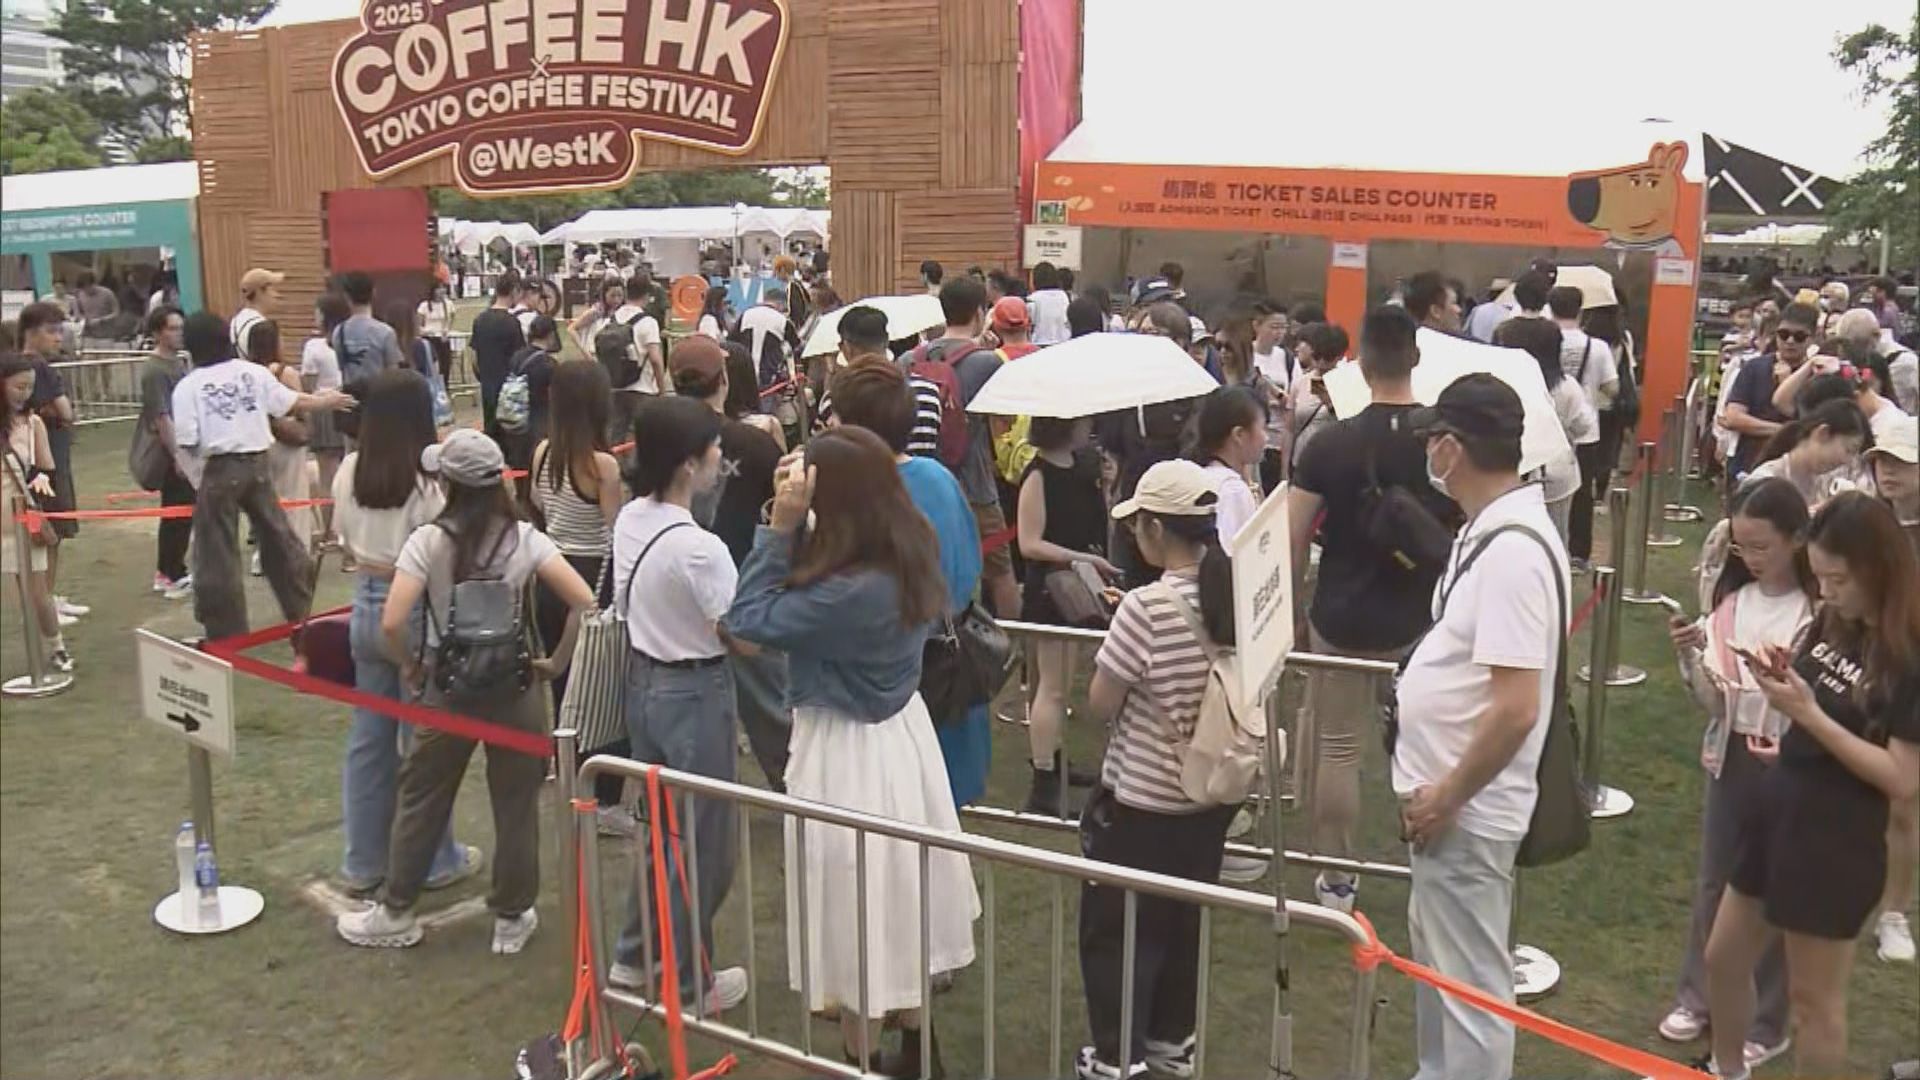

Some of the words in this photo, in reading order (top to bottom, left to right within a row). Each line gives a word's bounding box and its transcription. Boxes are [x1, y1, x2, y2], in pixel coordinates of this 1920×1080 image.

[374, 3, 424, 27] 2025
[342, 0, 625, 113] COFFEE
[643, 0, 773, 87] HK
[364, 96, 461, 155] TOKYO
[466, 76, 584, 118] COFFEE
[589, 74, 738, 129] FESTIVAL
[469, 131, 617, 177] @WestK
[1221, 205, 1262, 217] TICKET
[1227, 182, 1306, 202] TICKET
[1310, 185, 1380, 205] SALES
[1386, 189, 1498, 210] COUNTER
